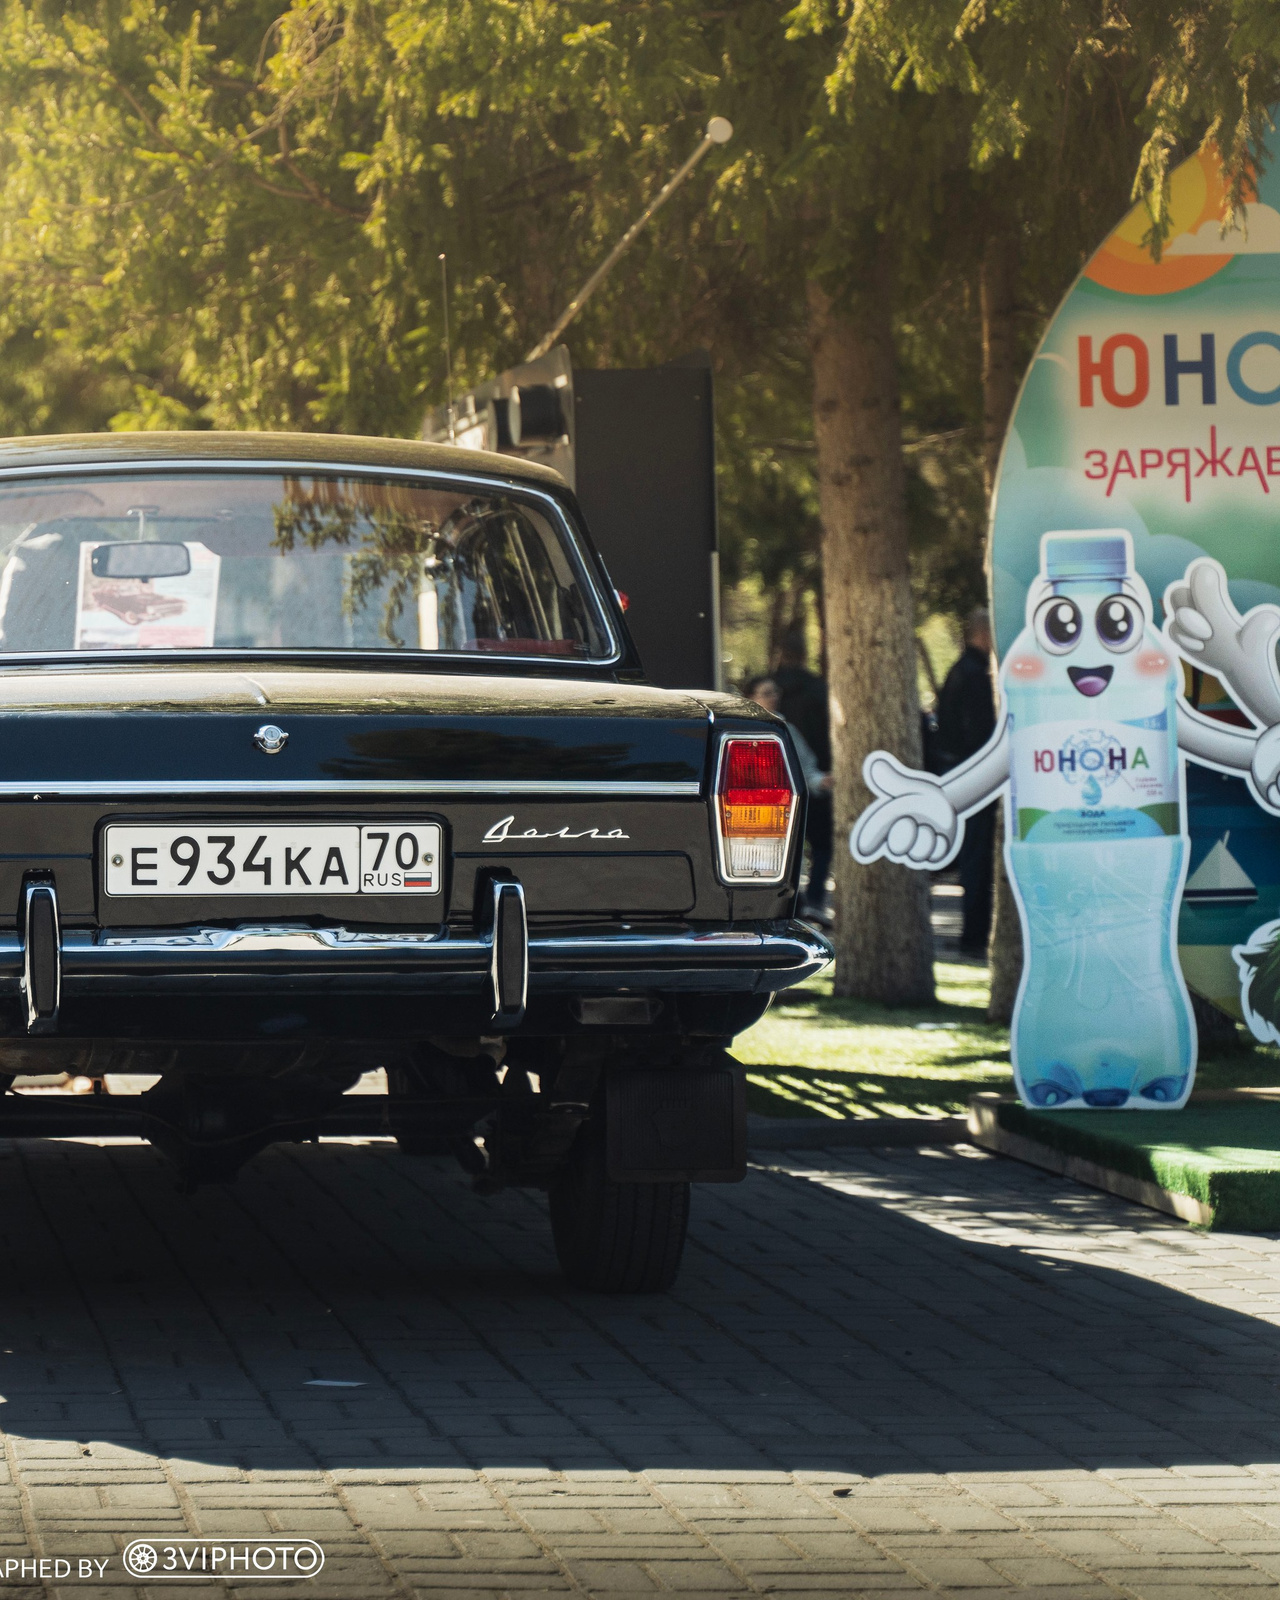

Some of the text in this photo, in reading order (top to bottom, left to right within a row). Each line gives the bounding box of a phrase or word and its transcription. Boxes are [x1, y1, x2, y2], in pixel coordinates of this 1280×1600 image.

[1078, 331, 1280, 409] ЮНО
[1084, 425, 1280, 502] ЗАРЯЖАЕ
[1034, 747, 1150, 773] ЮНОНА
[131, 832, 419, 886] Е934КА 70
[363, 873, 402, 887] RUS
